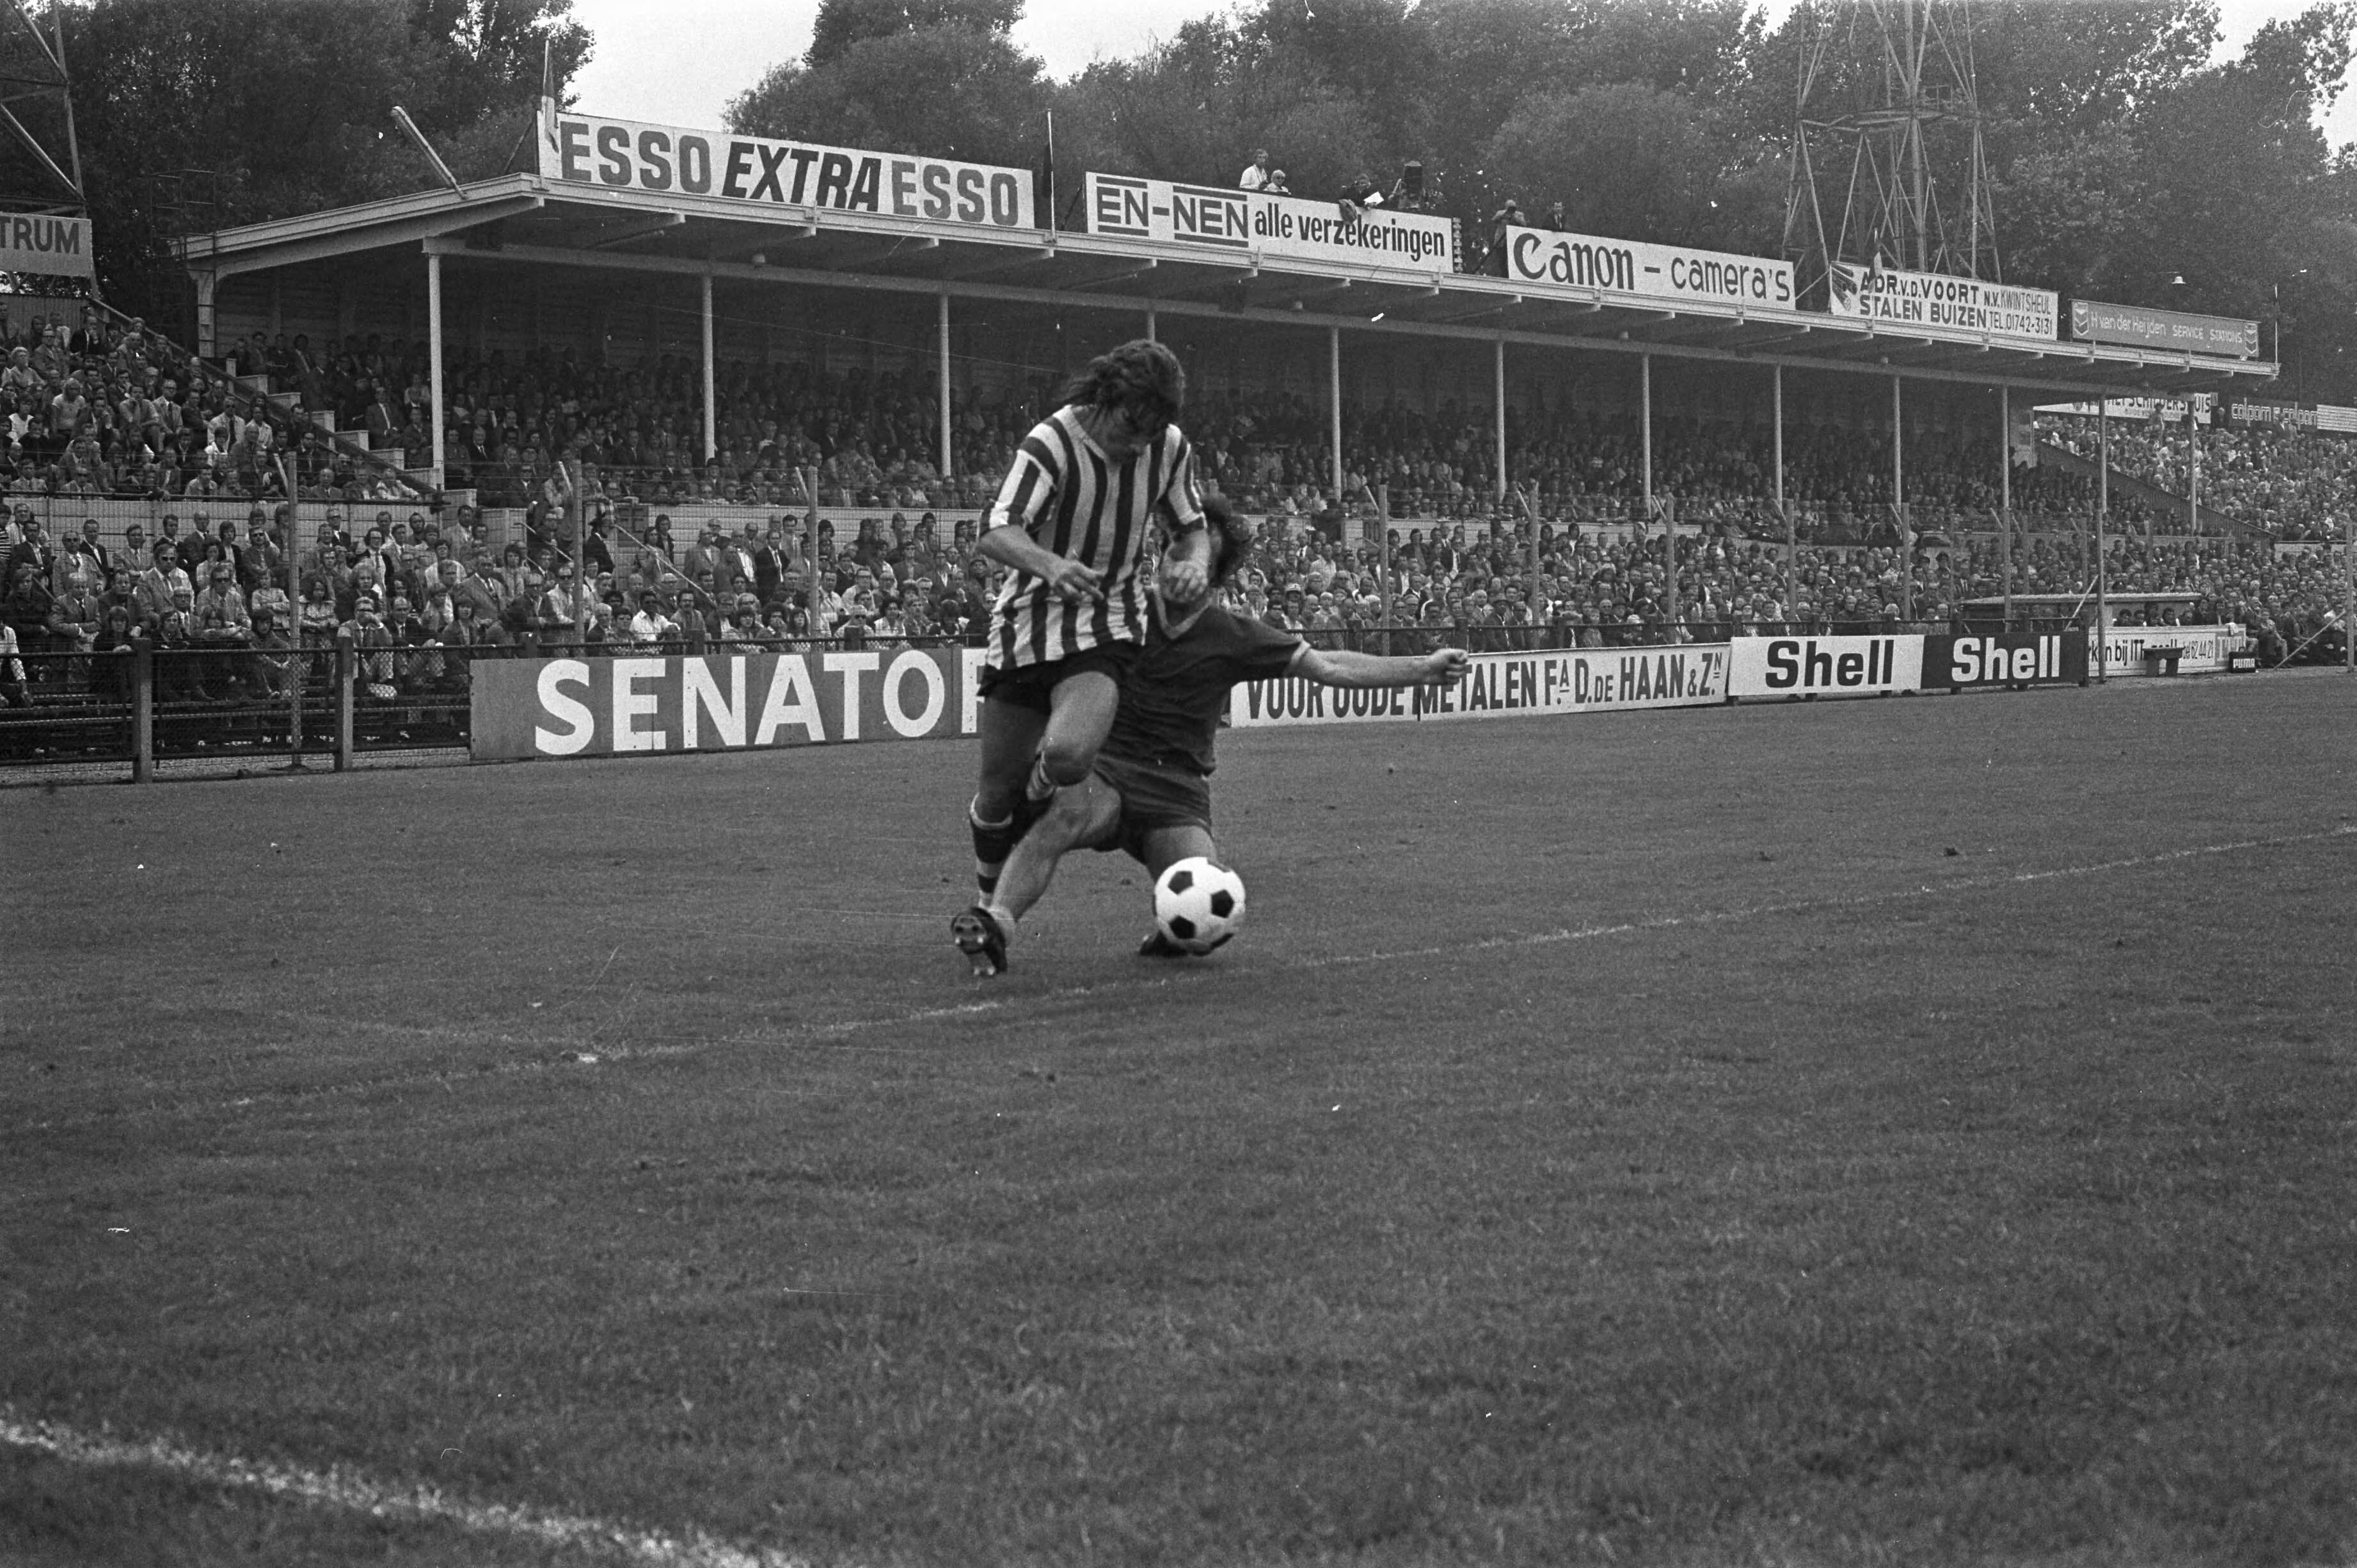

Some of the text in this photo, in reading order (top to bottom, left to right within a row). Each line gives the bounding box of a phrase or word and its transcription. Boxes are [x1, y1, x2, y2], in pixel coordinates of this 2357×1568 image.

[560, 120, 1019, 226] ESSO EXTRA ESSO
[1255, 202, 1293, 239] alle
[1298, 214, 1445, 262] verzekeringen
[1513, 232, 1635, 290] Canon
[1671, 256, 1790, 301] camera's
[1859, 294, 1923, 321] STALEN
[1930, 302, 1987, 328] BUIZEN
[2099, 316, 2116, 329] van
[2117, 314, 2131, 331] der
[2172, 324, 2203, 340] SERVICE
[1765, 639, 1894, 688] Shell
[1951, 635, 2060, 682] Shell
[2115, 639, 2128, 666] bij
[1619, 654, 1685, 701] HAAN
[1687, 669, 1697, 697] &
